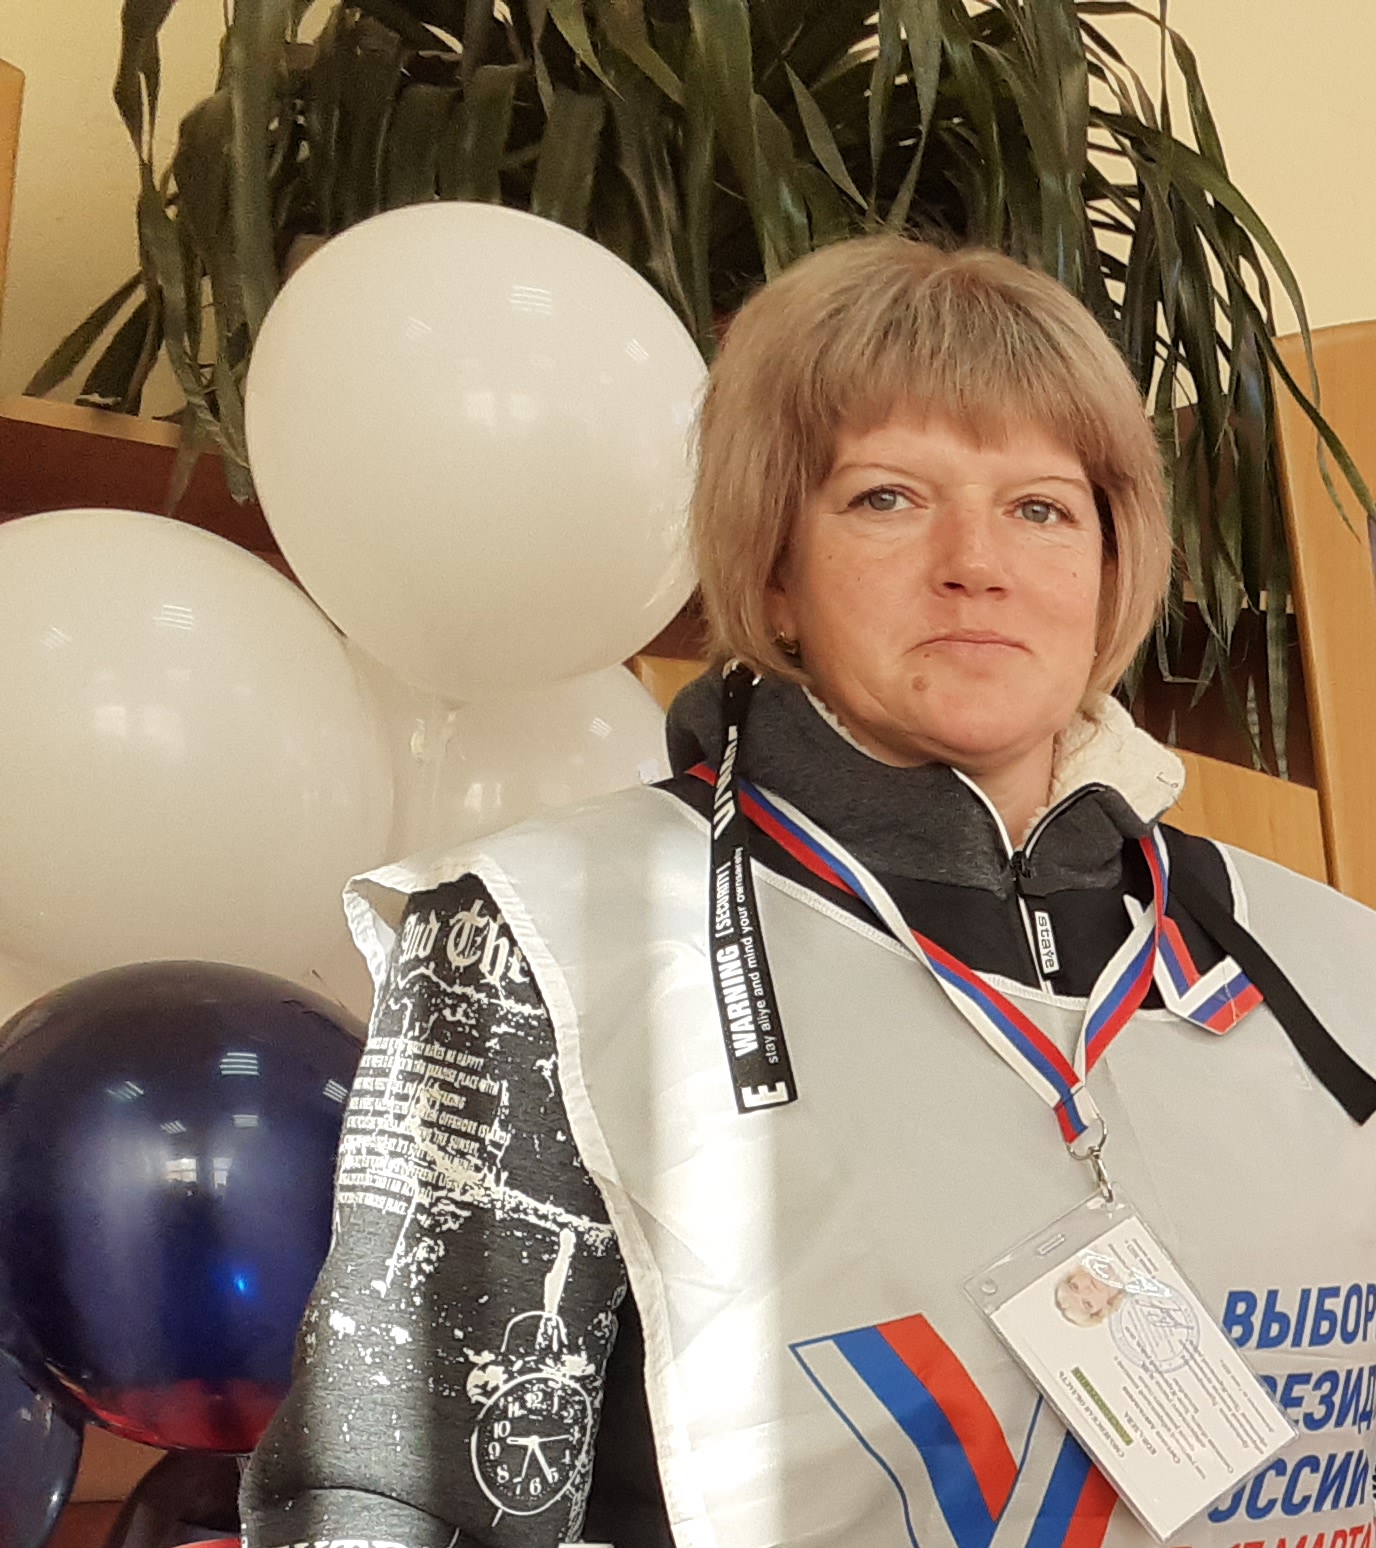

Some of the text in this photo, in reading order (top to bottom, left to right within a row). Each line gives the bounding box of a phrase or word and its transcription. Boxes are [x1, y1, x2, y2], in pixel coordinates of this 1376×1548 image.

[738, 904, 753, 934] your
[744, 936, 758, 967] mind
[751, 972, 764, 997] and
[715, 943, 759, 1058] WARNING
[763, 1035, 778, 1063] stay
[438, 1110, 478, 1134] OFFSHORE
[493, 1421, 511, 1439] 10
[488, 1441, 500, 1460] 9
[497, 1464, 509, 1484] 8
[529, 1478, 541, 1496] 6
